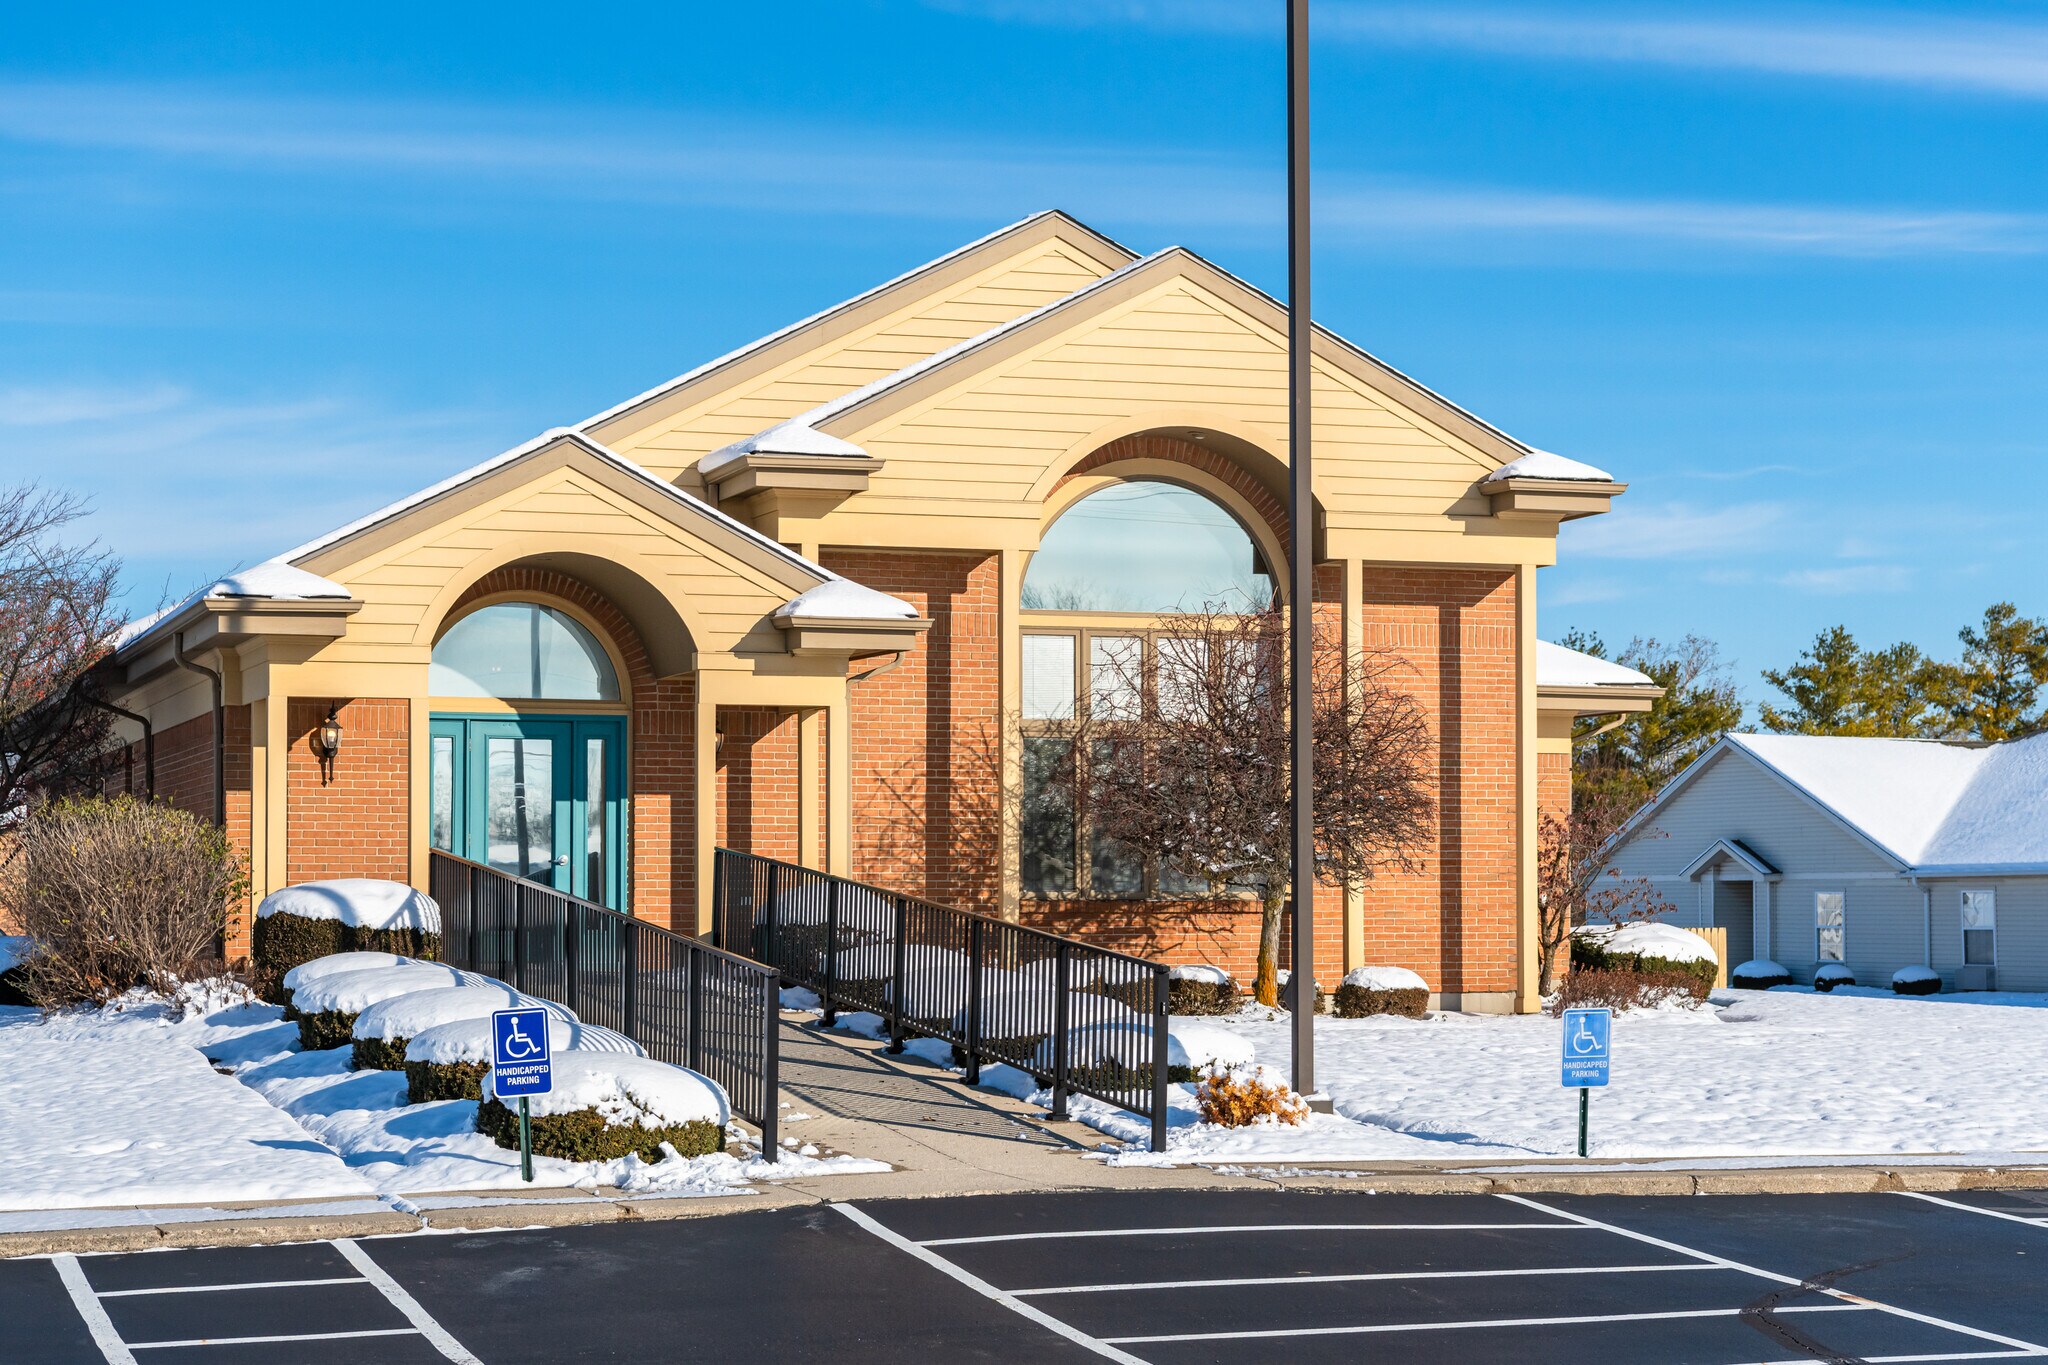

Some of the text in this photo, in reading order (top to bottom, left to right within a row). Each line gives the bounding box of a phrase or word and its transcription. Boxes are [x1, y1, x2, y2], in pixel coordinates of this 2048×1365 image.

[1563, 1061, 1607, 1069] HANDICAPPED
[497, 1065, 549, 1076] HANDICAPPED
[507, 1076, 540, 1086] PARKING
